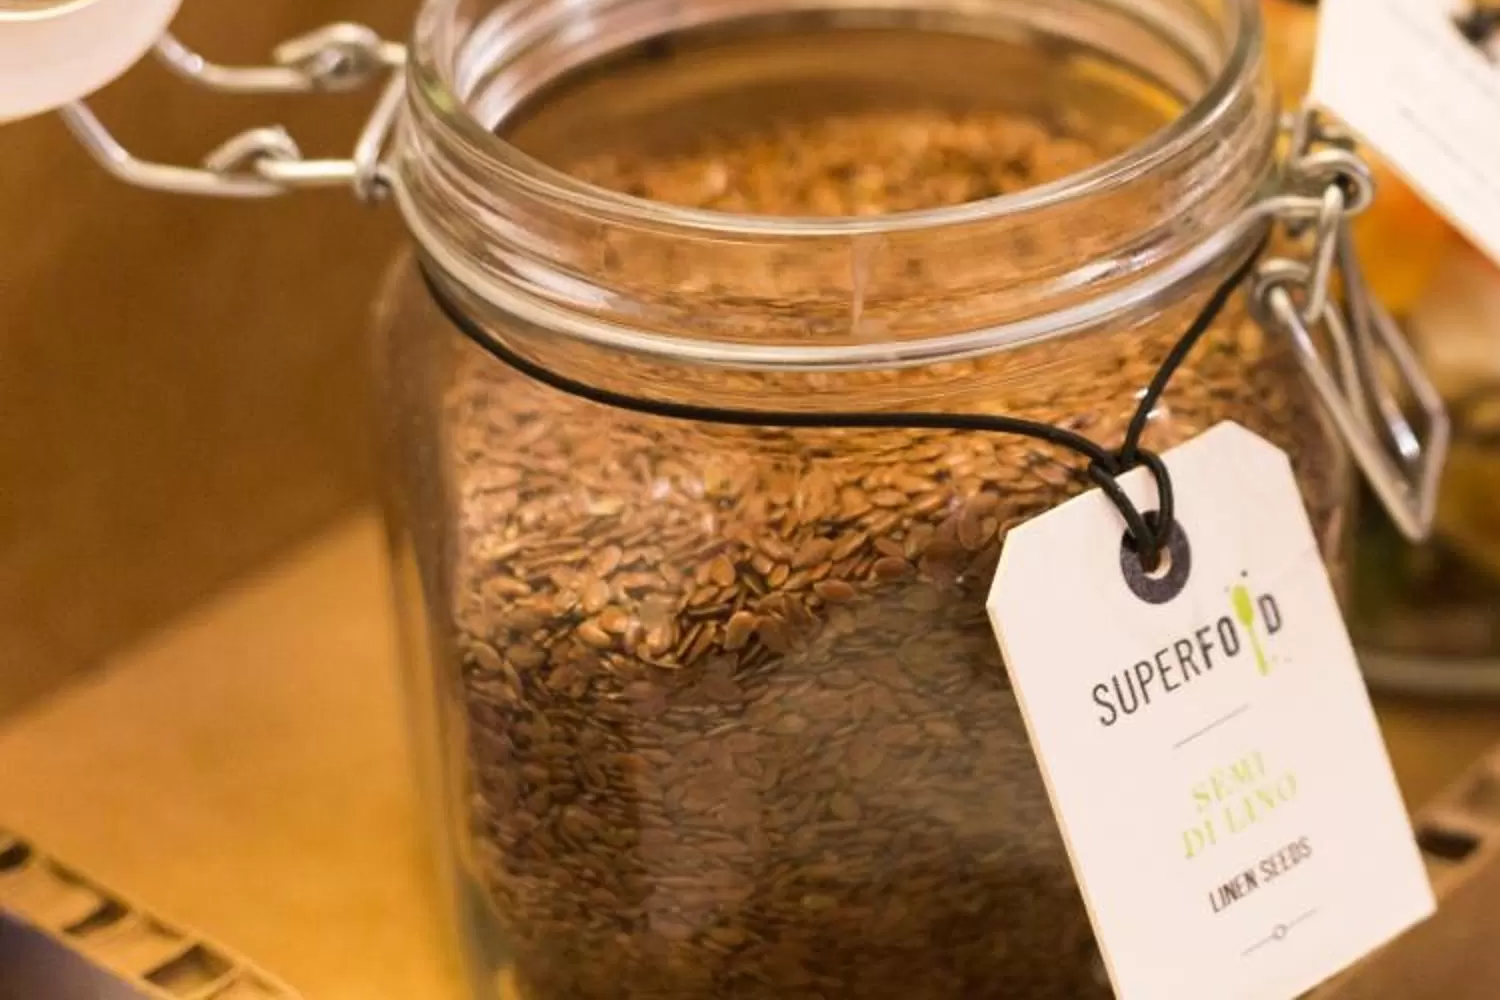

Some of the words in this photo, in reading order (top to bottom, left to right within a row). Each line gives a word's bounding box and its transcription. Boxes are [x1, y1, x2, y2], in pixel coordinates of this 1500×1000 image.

[1181, 819, 1218, 859] DI
[1223, 770, 1298, 834] LINO
[1191, 750, 1266, 813] SEMI
[1208, 867, 1260, 914] LINEN
[1258, 836, 1313, 884] SEEDS
